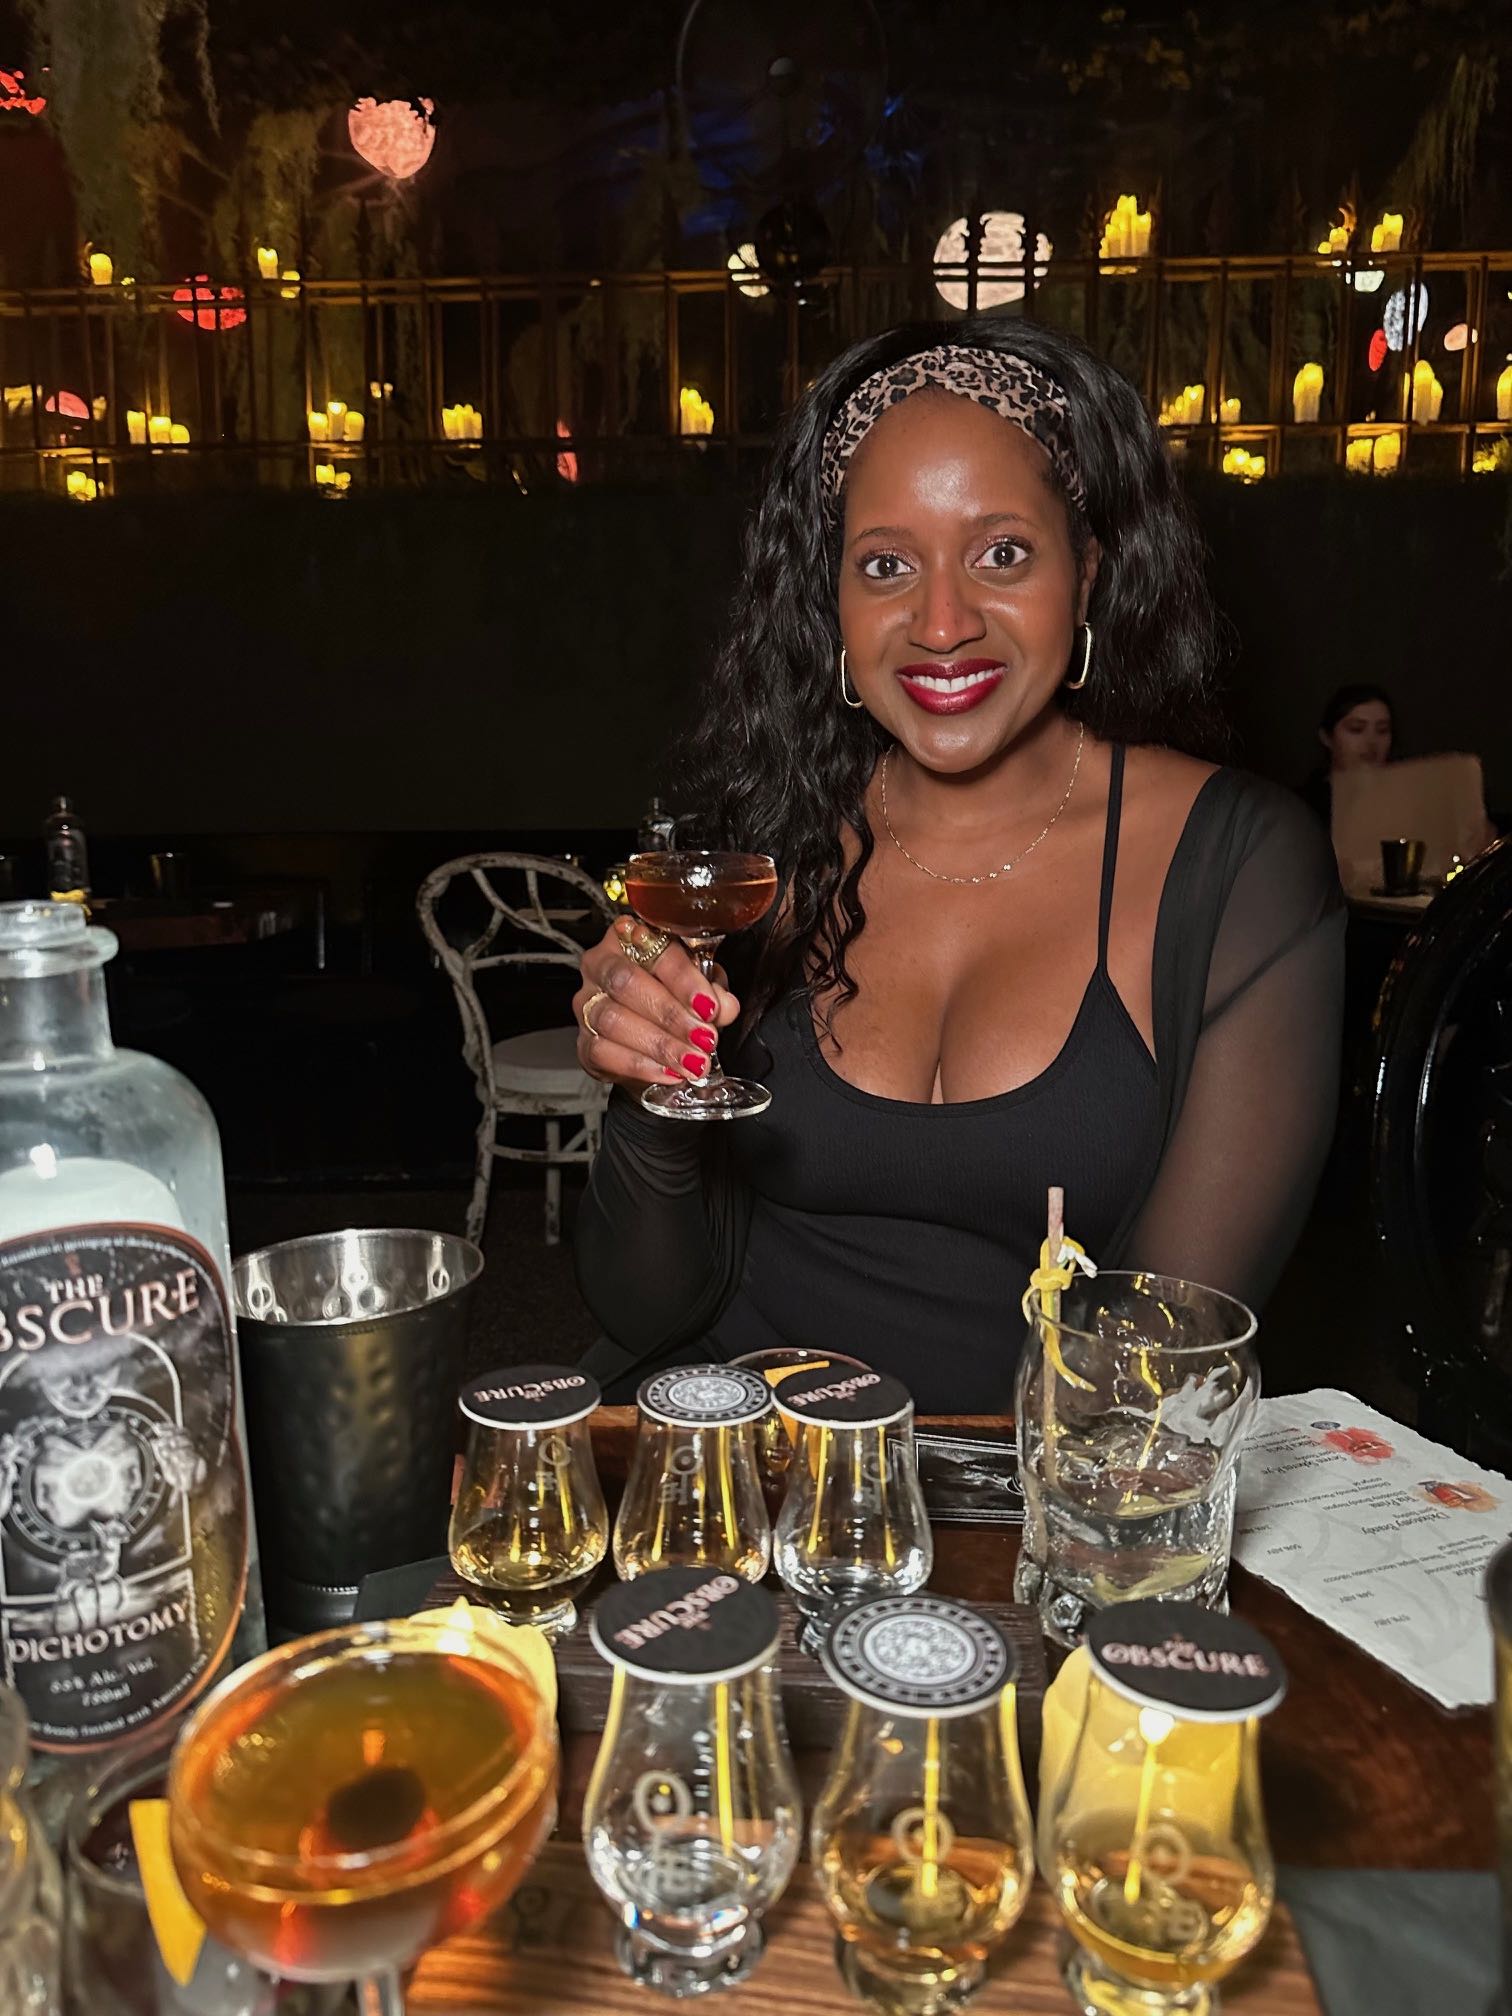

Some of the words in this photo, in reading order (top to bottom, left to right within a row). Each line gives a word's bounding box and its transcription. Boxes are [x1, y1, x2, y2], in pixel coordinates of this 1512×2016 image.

[40, 1273, 104, 1303] THE
[474, 1375, 586, 1402] OBSCURE
[6, 1600, 189, 1663] DICHOTOMY
[1101, 1642, 1270, 1677] OBSCURE
